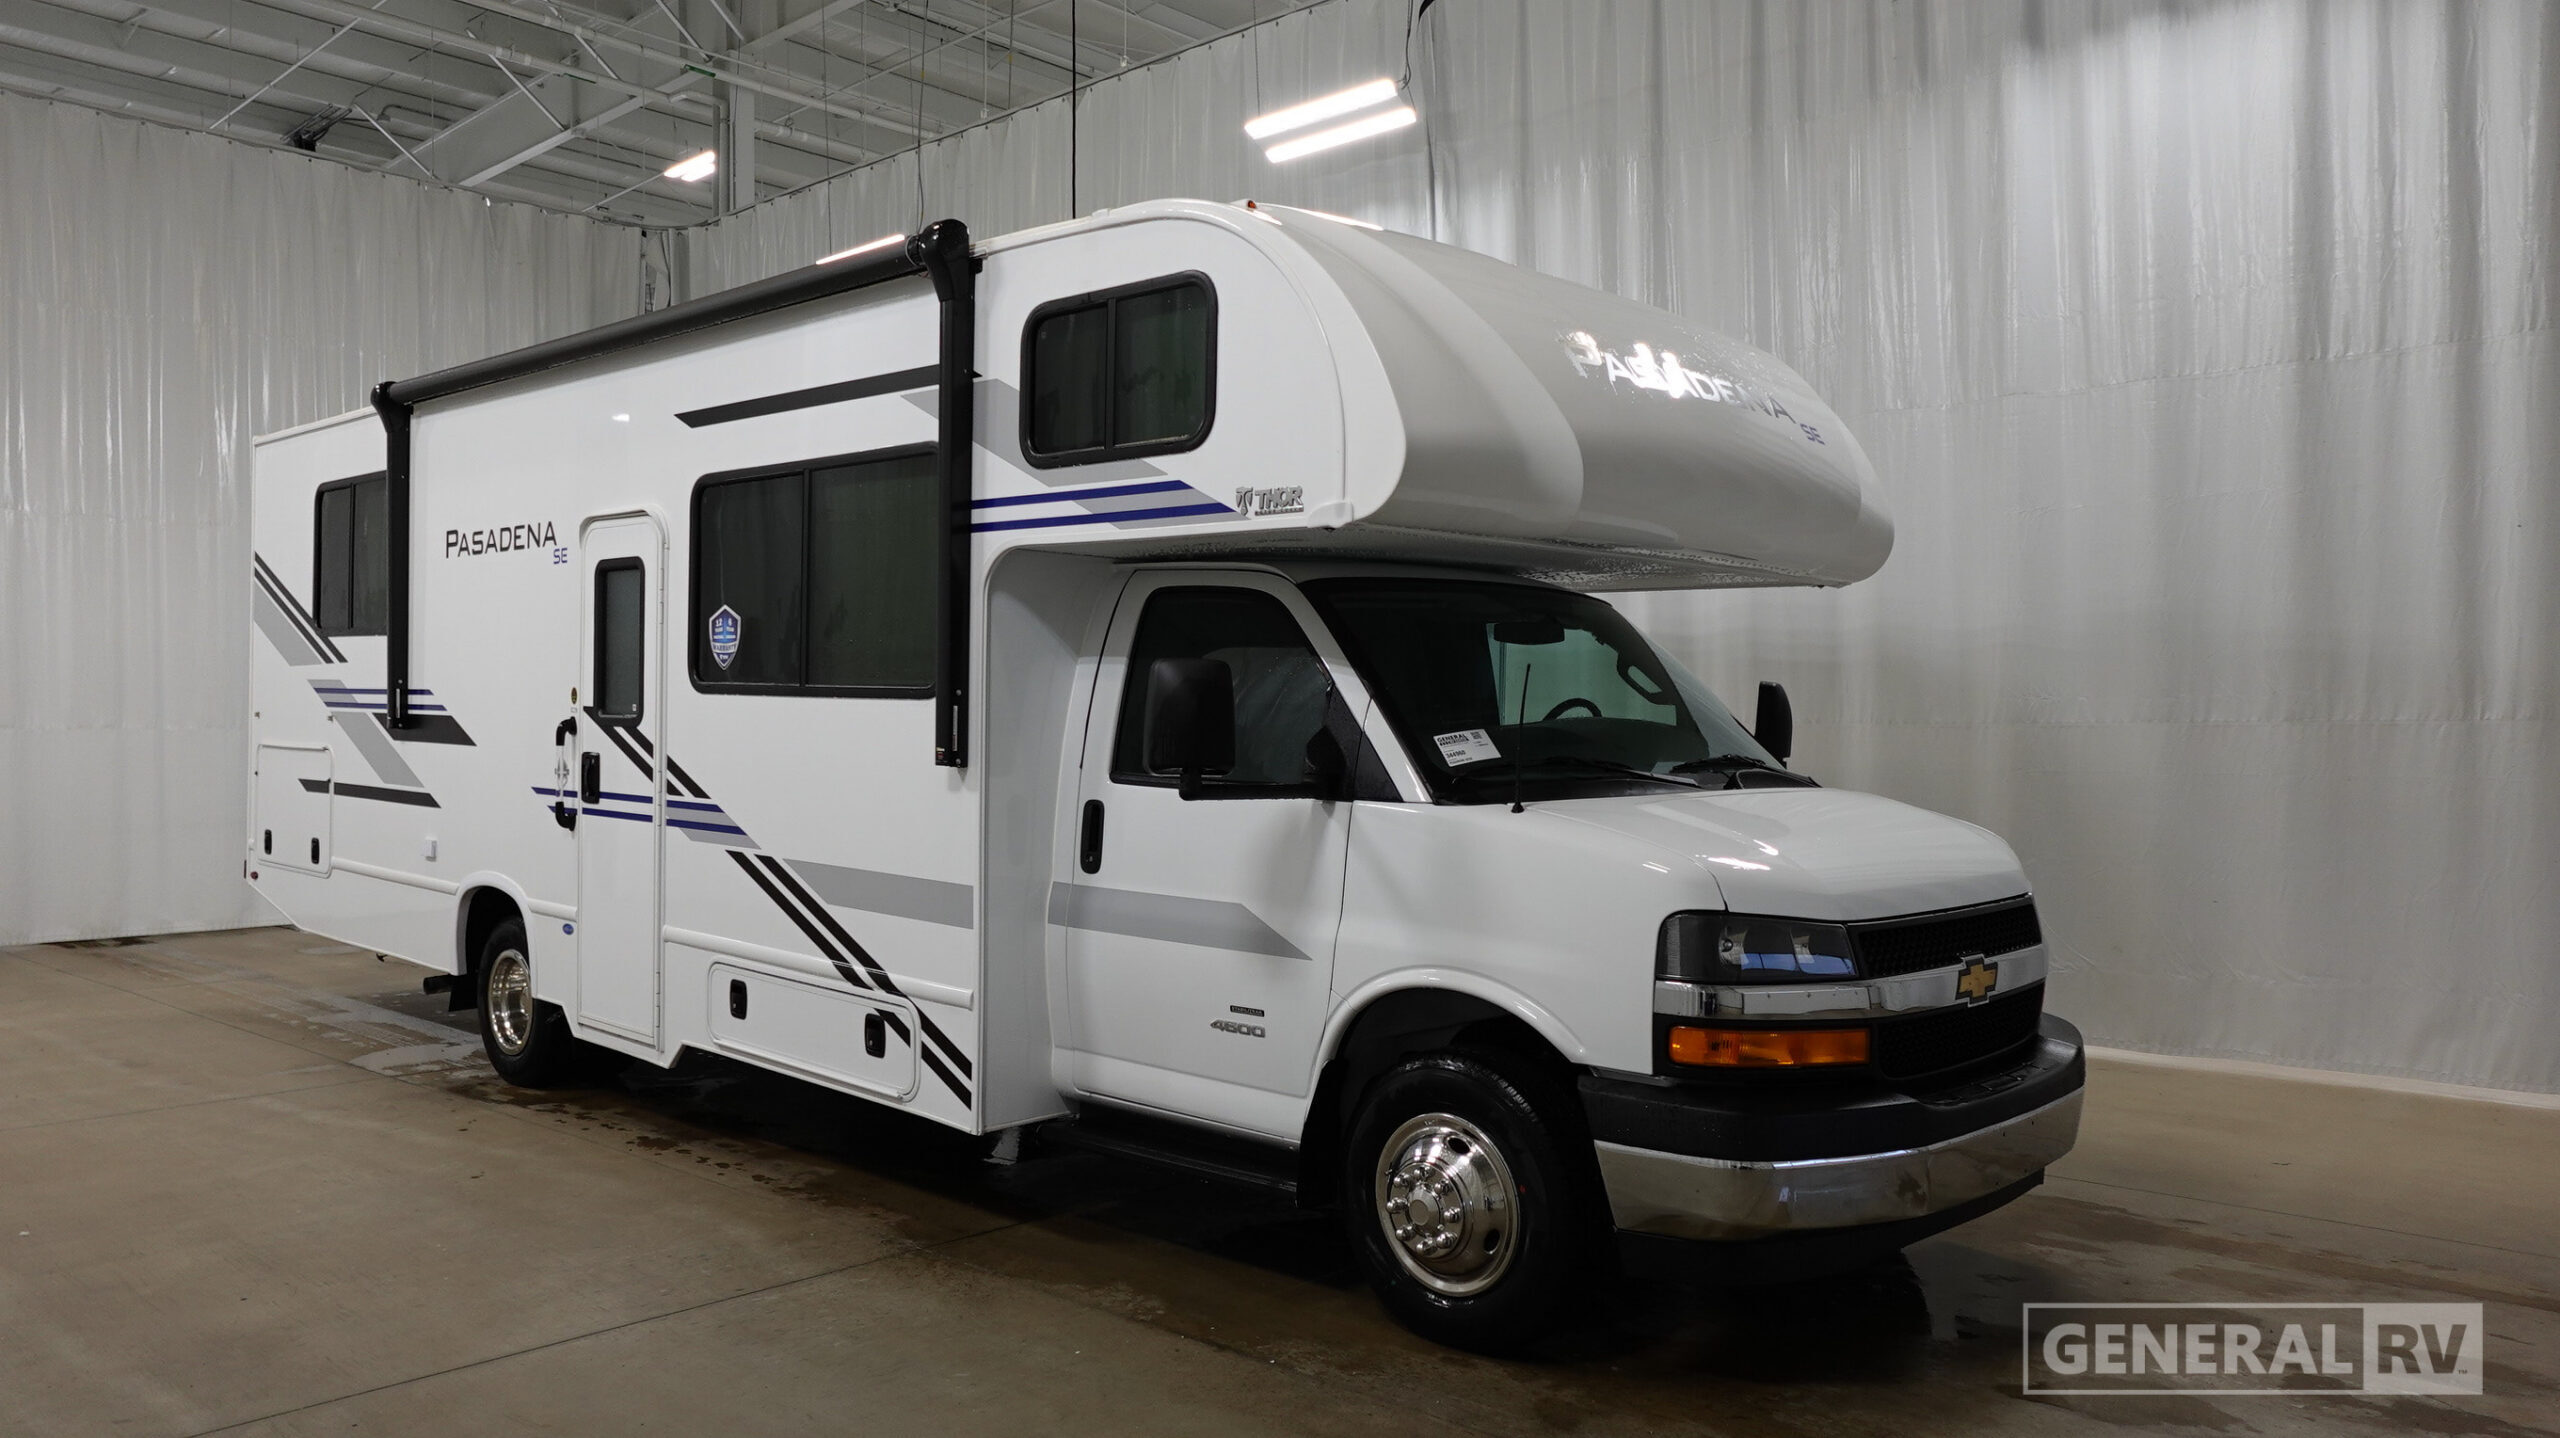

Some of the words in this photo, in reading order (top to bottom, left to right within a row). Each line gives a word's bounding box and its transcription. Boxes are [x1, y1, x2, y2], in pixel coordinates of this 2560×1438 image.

[1800, 423, 1825, 445] SE
[1255, 486, 1304, 510] THOR
[445, 521, 557, 559] PASADENA
[553, 547, 568, 565] SE
